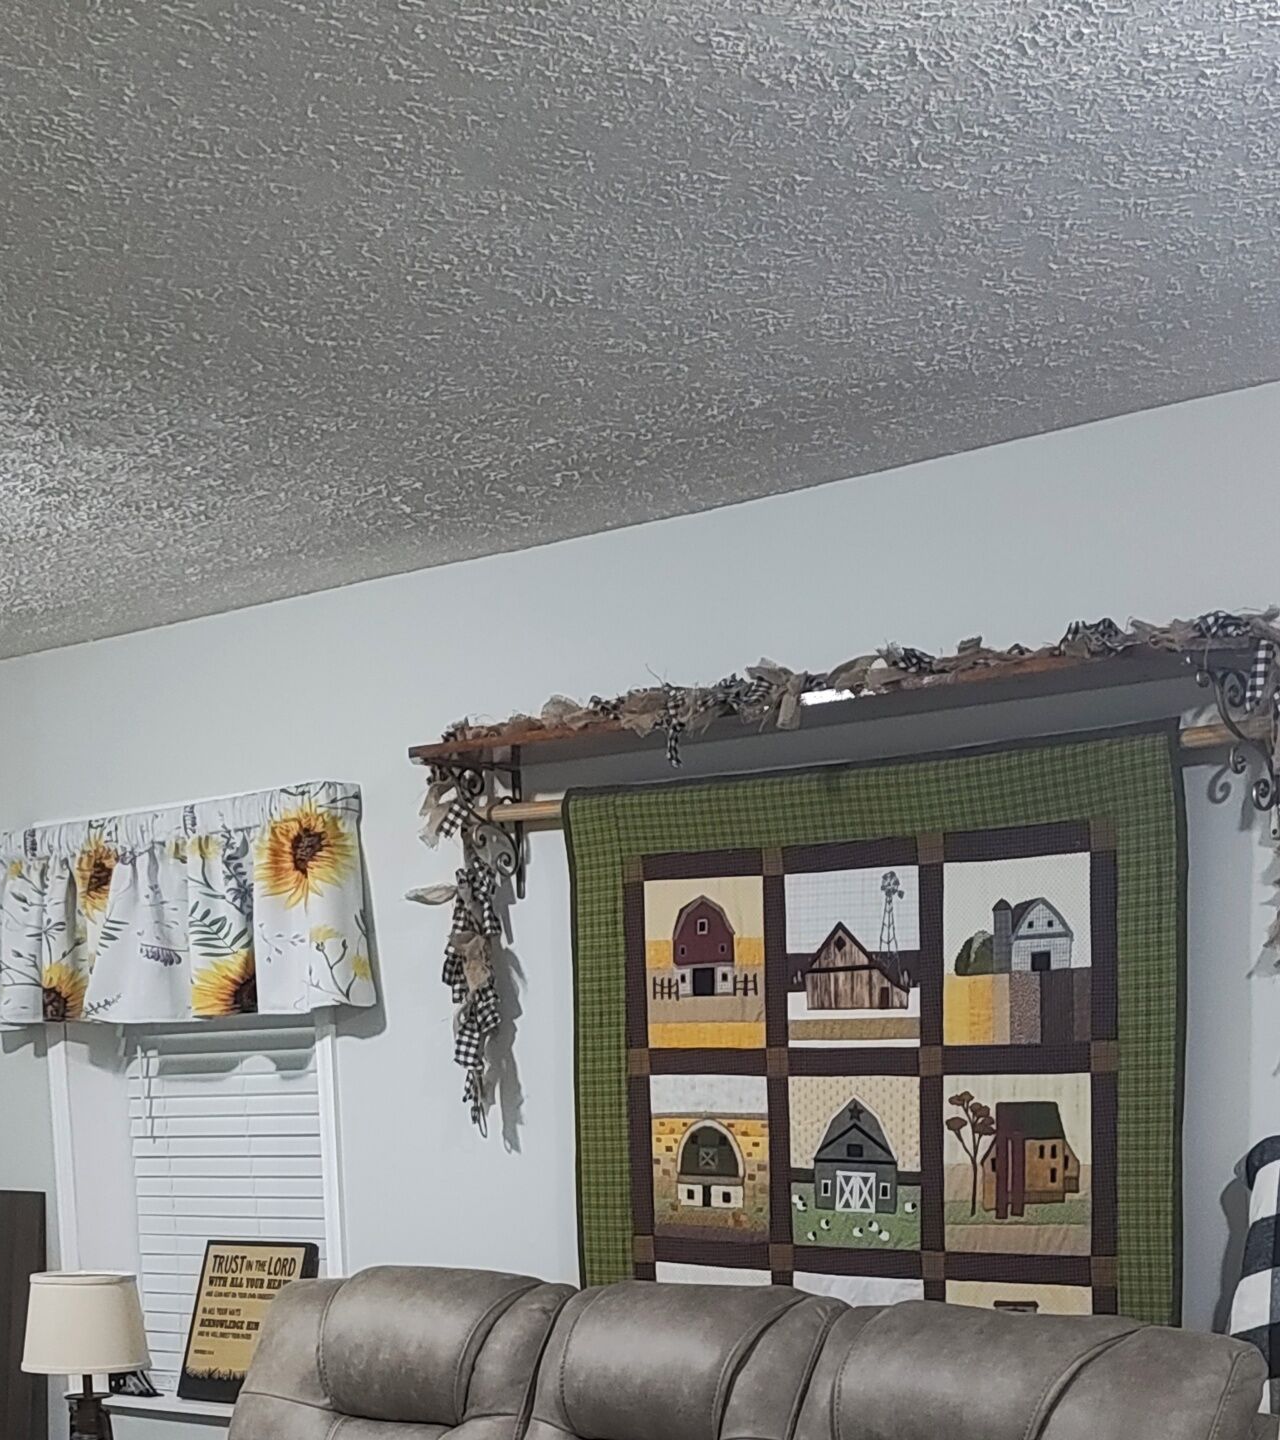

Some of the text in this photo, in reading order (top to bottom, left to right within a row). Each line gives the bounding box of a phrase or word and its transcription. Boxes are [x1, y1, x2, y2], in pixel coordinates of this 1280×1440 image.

[212, 1254, 296, 1277] TRUST IN THE LORD
[209, 1276, 228, 1287] WITH
[229, 1277, 244, 1288] ALL
[246, 1278, 264, 1289] YOUR
[199, 1318, 245, 1330] ACKNOWLEDGE
